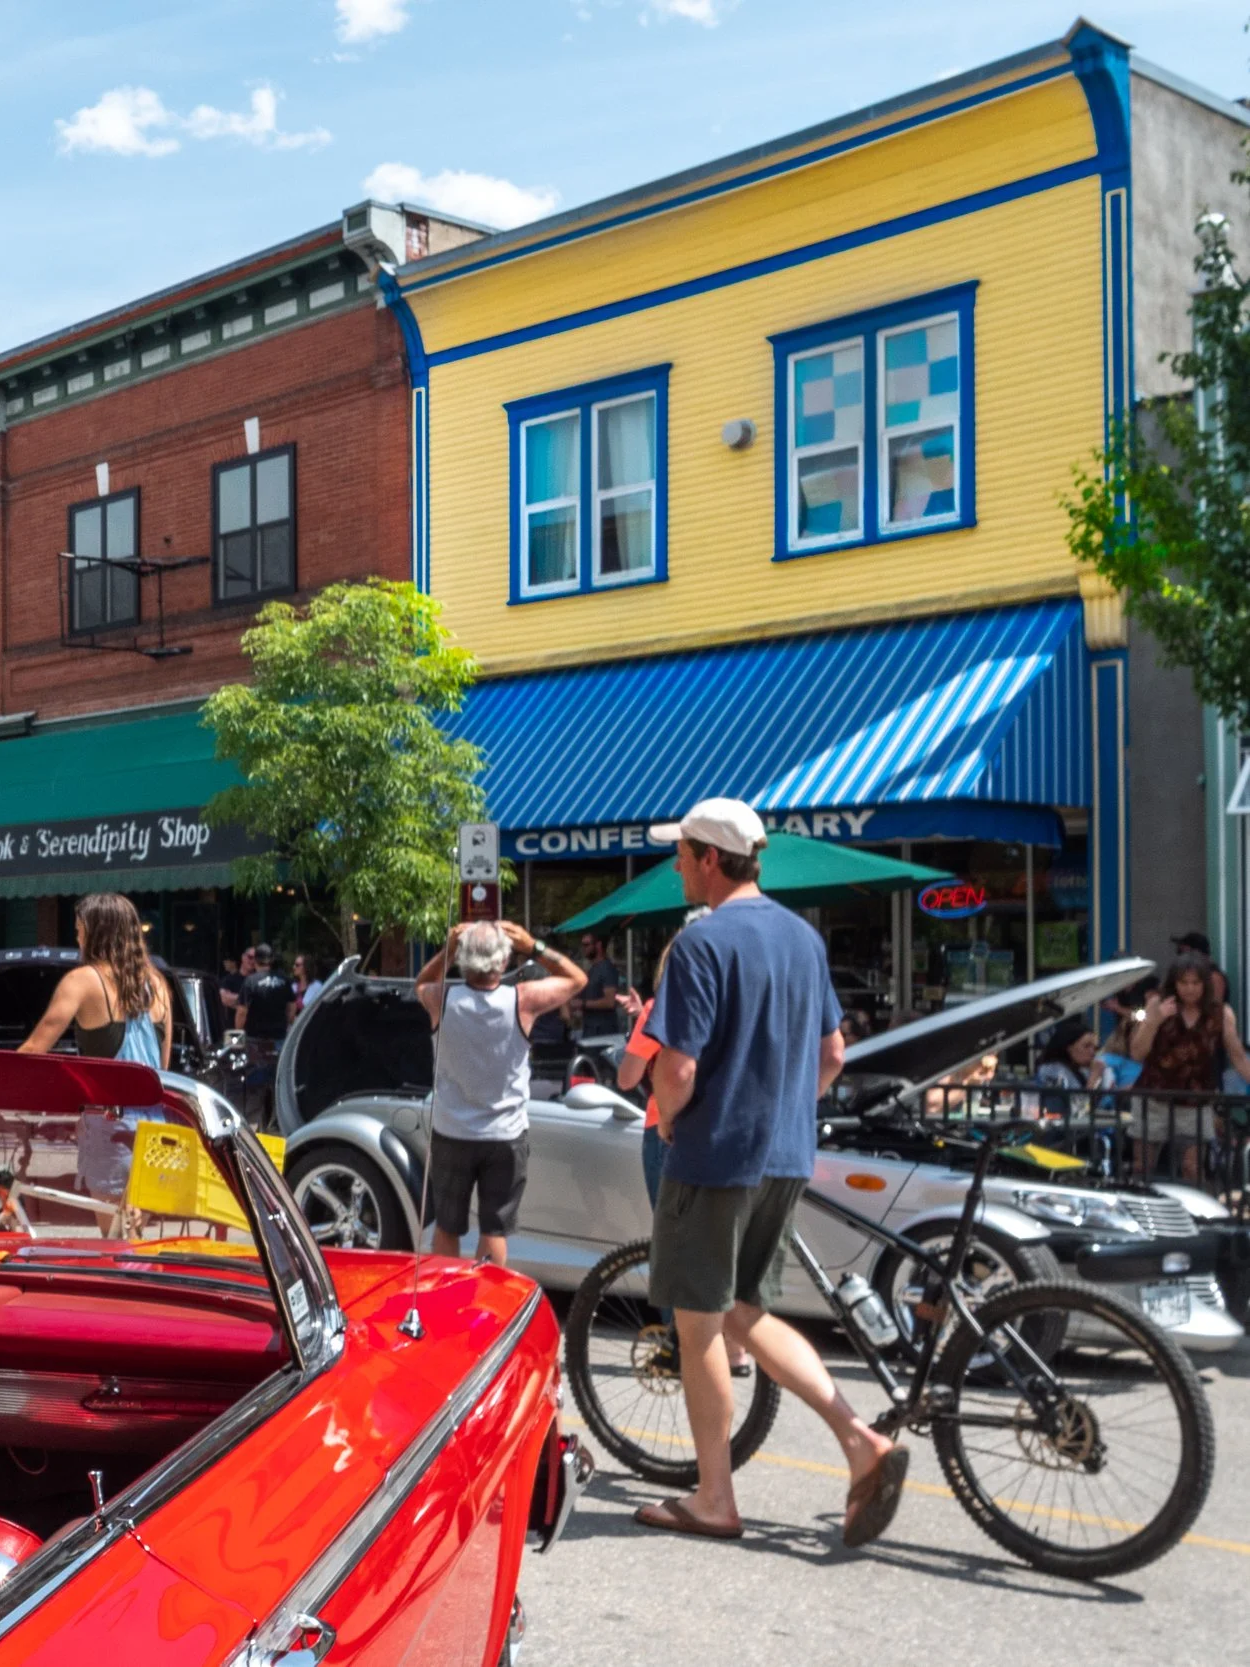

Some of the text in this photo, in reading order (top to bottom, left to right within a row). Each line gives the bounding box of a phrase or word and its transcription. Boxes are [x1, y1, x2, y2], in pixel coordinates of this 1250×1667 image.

[19, 835, 30, 855] &
[36, 820, 151, 863] Serendipity
[157, 816, 210, 858] Shop
[515, 810, 875, 856] CONFEARY
[921, 883, 986, 909] OPEN
